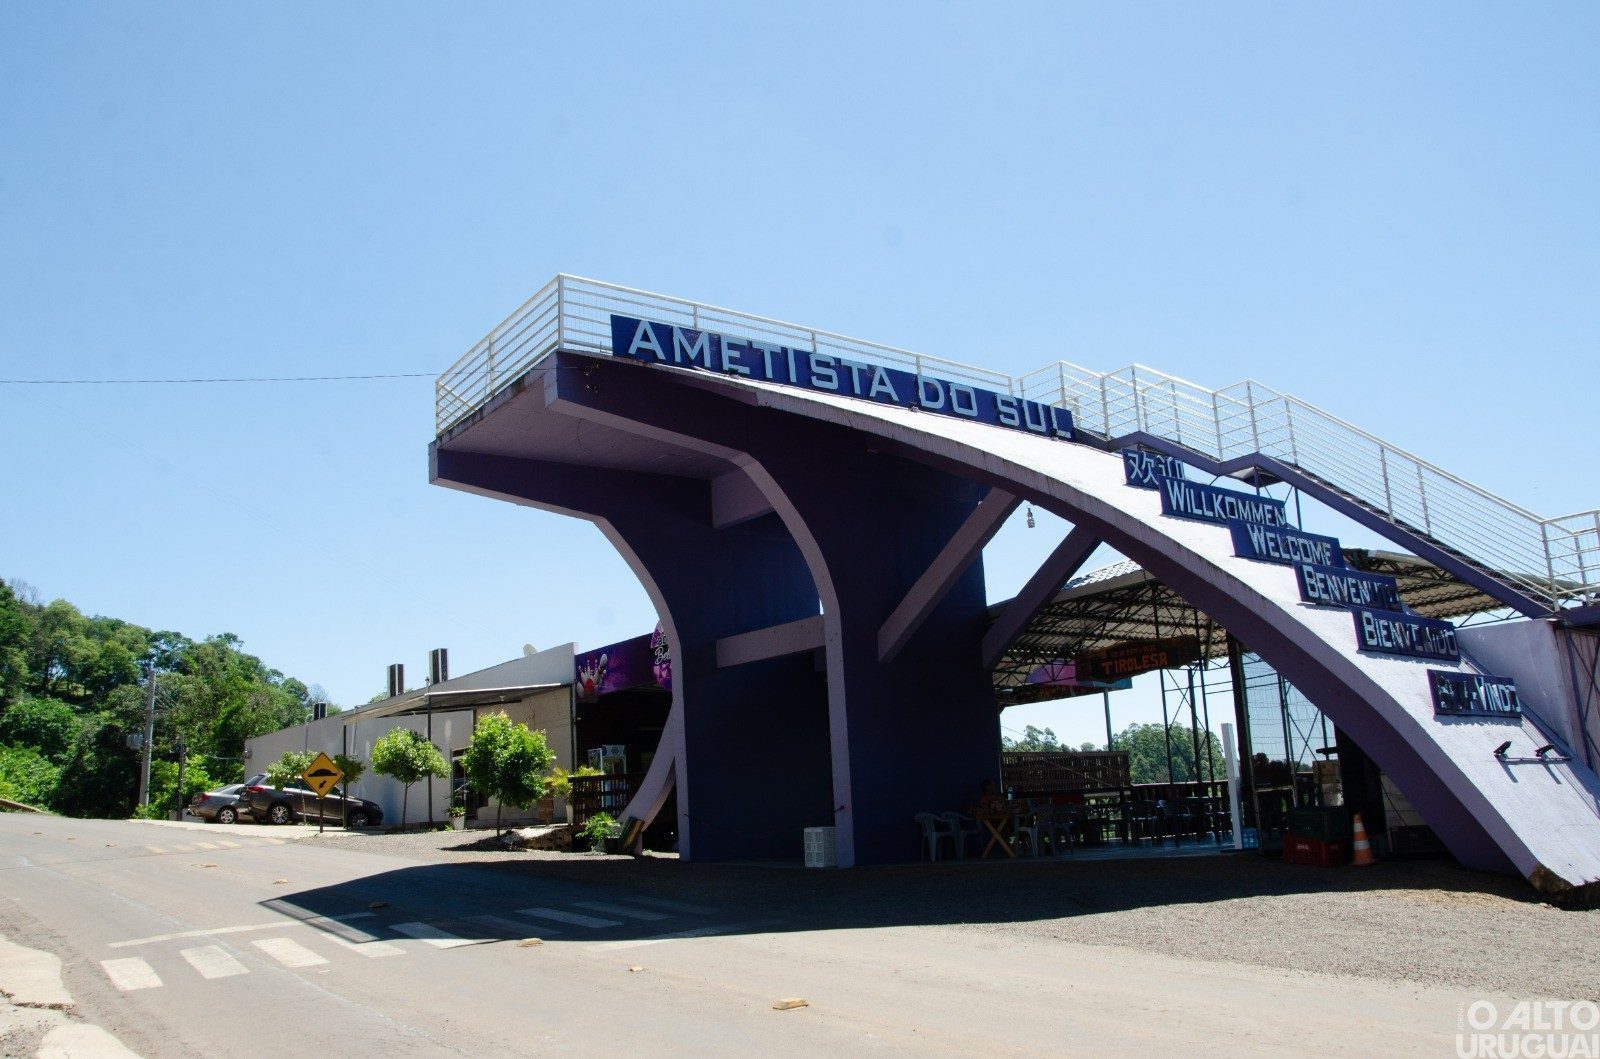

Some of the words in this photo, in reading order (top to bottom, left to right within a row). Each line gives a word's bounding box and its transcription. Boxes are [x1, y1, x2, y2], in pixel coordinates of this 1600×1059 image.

[628, 320, 899, 401] AMETISTA
[917, 375, 979, 416] DO
[996, 394, 1072, 439] SUL
[1166, 479, 1288, 527] WILLKOMMEN
[1247, 523, 1331, 566] WELCOME
[1101, 651, 1168, 676] TIROLESA
